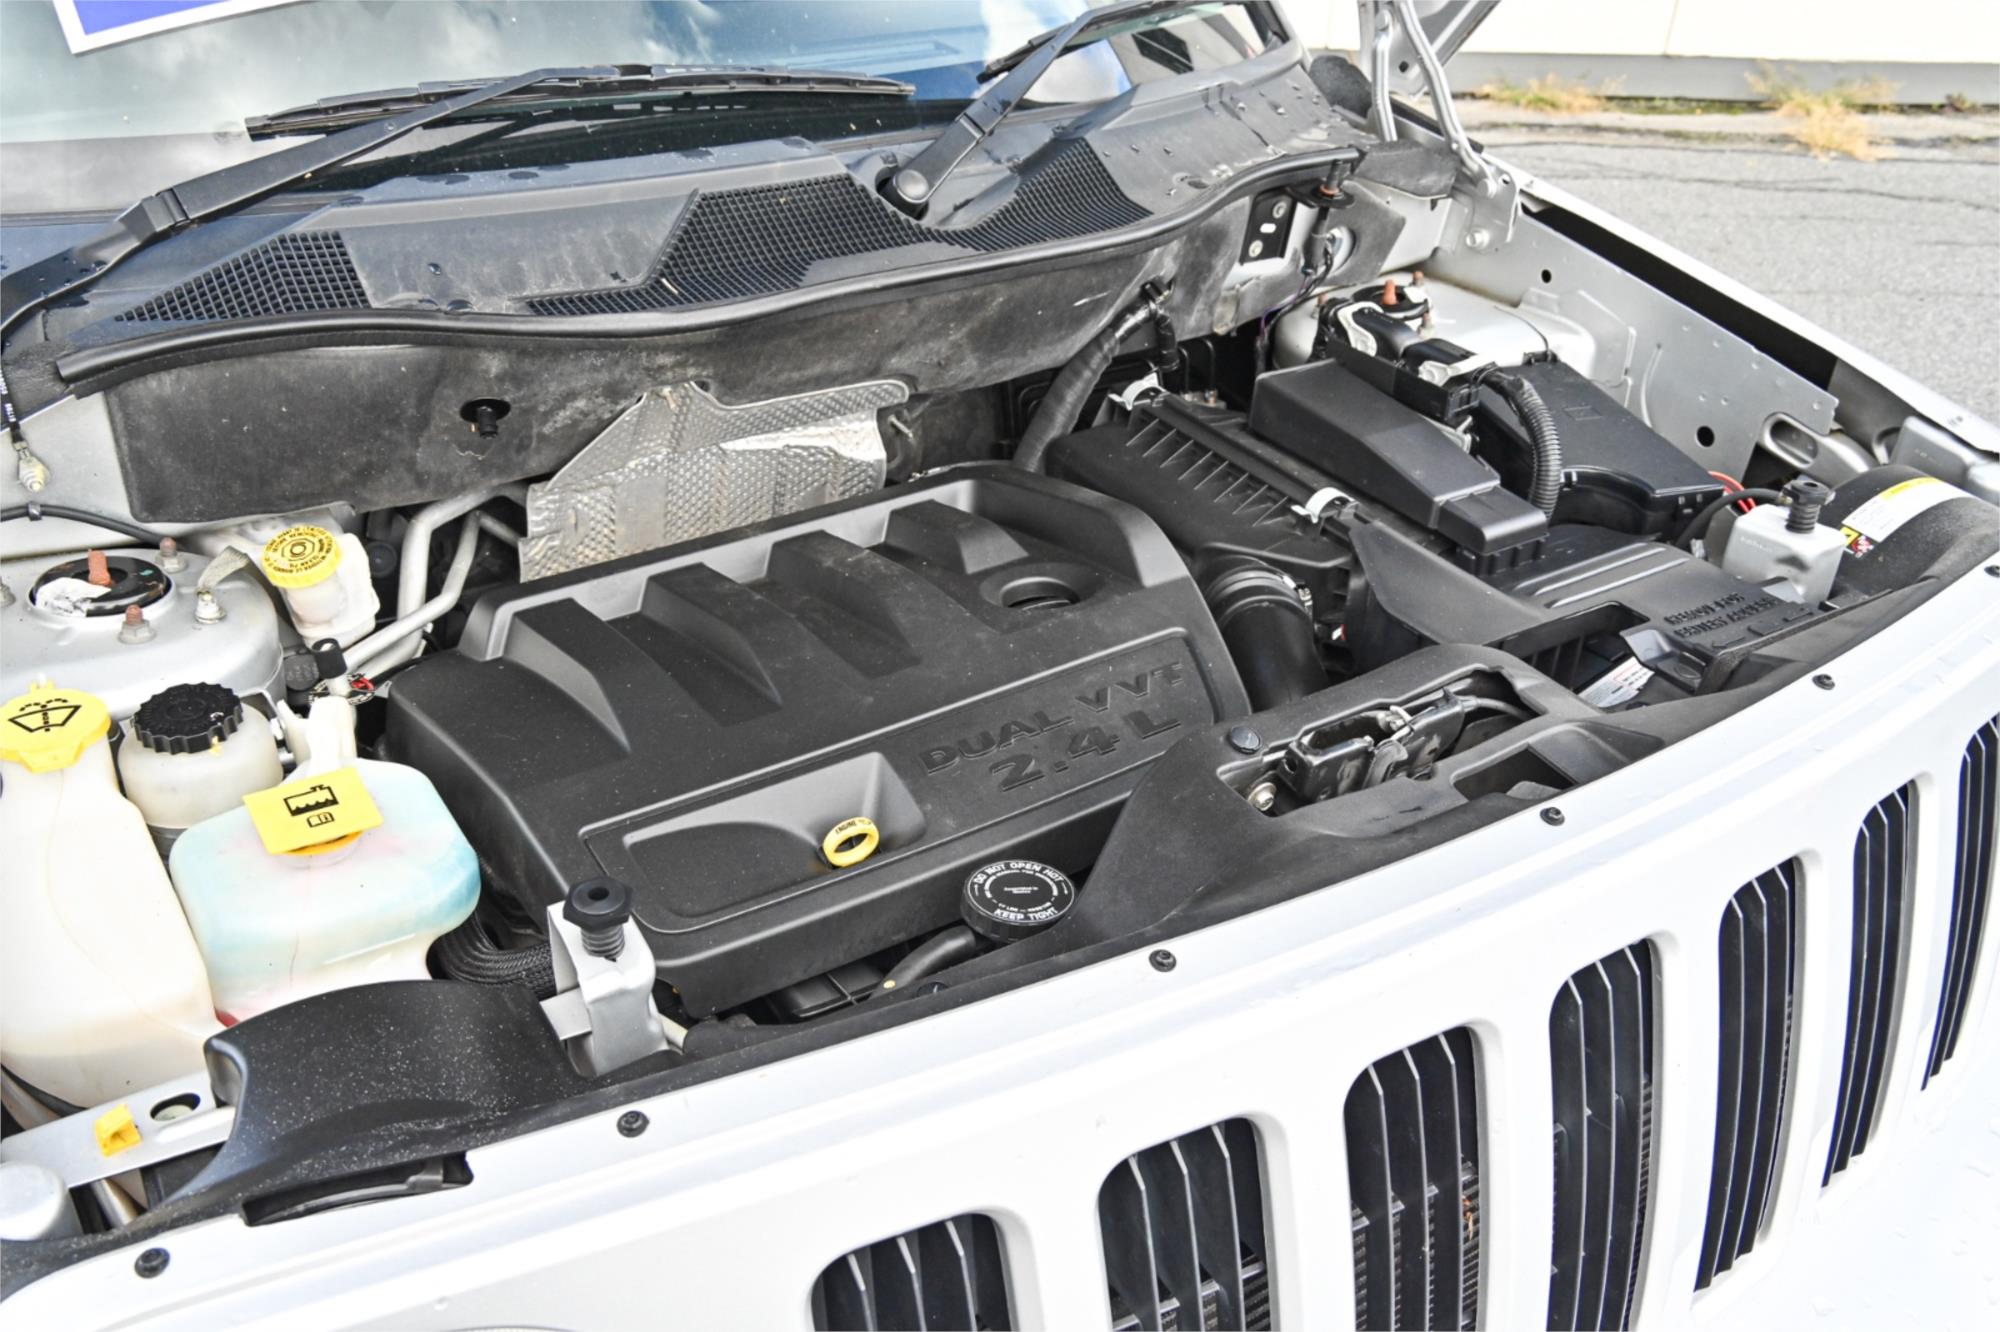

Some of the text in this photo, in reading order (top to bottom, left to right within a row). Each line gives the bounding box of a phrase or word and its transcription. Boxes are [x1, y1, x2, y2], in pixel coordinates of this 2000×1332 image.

[919, 661, 1184, 776] DUAL VVT
[973, 873, 988, 885] DO
[984, 863, 1006, 875] NOT
[1009, 861, 1042, 872] OPEN
[993, 907, 1026, 921] KEEP
[1026, 905, 1059, 920] TIGHT
